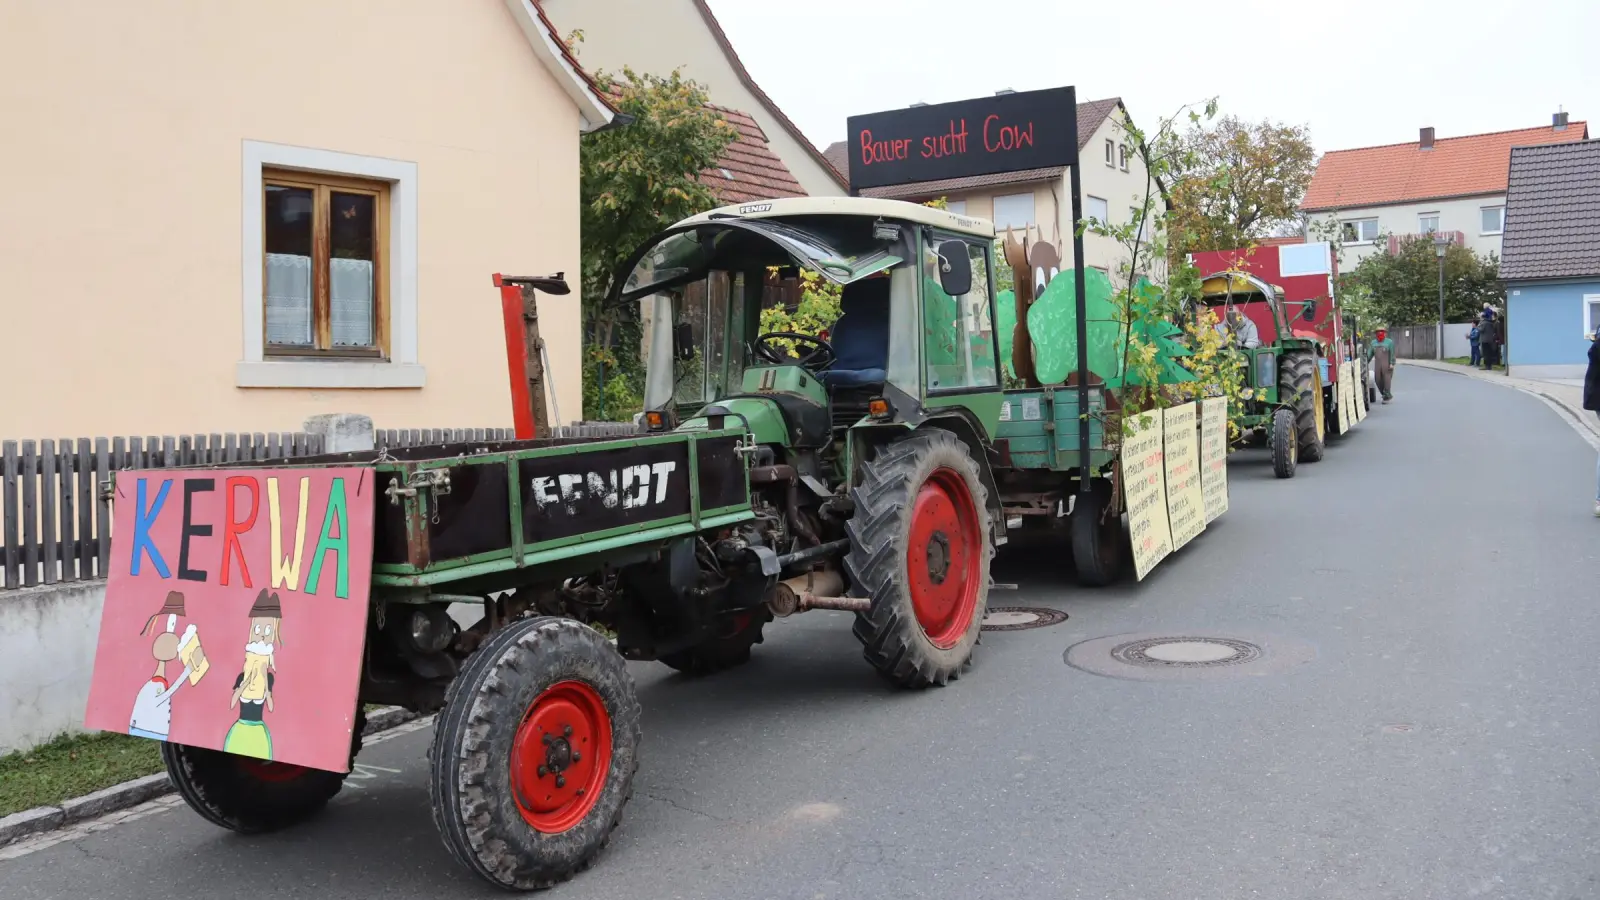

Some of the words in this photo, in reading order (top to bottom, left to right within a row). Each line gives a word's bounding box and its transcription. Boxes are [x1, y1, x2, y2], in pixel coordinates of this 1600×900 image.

[860, 129, 912, 165] Bauer
[920, 118, 968, 158] sucht
[983, 114, 1033, 153] Cow
[740, 204, 772, 214] FENDT
[531, 461, 676, 516] FENDT
[130, 476, 349, 599] KERWA
